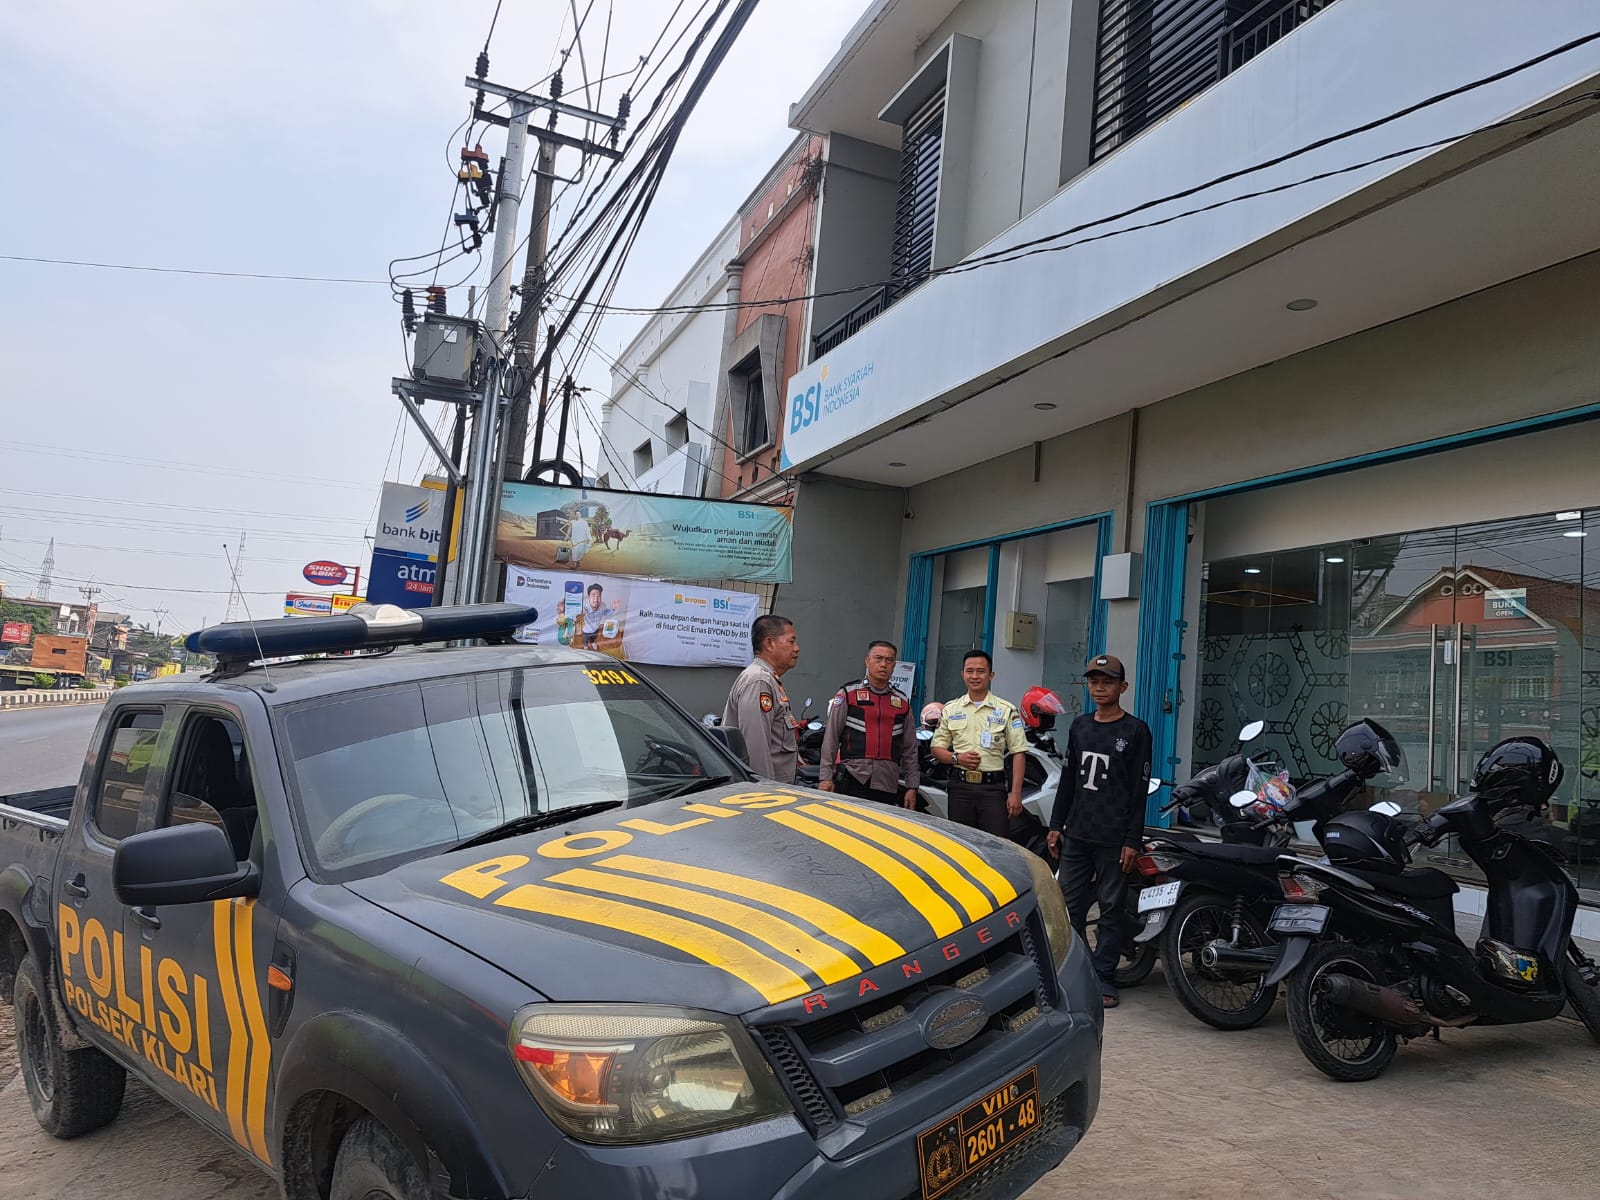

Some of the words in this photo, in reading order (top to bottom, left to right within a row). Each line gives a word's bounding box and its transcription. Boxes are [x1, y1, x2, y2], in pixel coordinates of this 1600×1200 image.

[824, 381, 842, 402] BANK
[844, 362, 874, 389] SYARIAH
[790, 381, 822, 436] BSI
[823, 386, 860, 418] INDONESIA
[738, 510, 755, 520] BSI
[382, 522, 416, 539] bank
[672, 523, 712, 535] Wujudkan
[714, 527, 754, 537] perjalanan
[755, 531, 778, 539] umrah
[716, 536, 737, 544] aman
[738, 537, 753, 545] dan
[754, 539, 777, 547] mudah
[308, 564, 338, 572] SHOP
[397, 563, 436, 583] atm
[408, 582, 417, 591] 24
[418, 583, 434, 593] Jam
[685, 597, 707, 605] BYOND
[713, 598, 729, 610] BSI
[1492, 600, 1517, 609] BUKA
[639, 609, 654, 618] Raih
[654, 612, 670, 620] masa
[670, 612, 690, 622] depan
[690, 615, 712, 625] dengan
[712, 617, 729, 628] harga
[729, 620, 742, 628] saat
[742, 621, 750, 629] ini
[655, 621, 662, 630] di
[662, 622, 677, 631] fitur
[676, 623, 691, 632] Cicil
[691, 625, 707, 634] Emas
[707, 627, 731, 637] BYOND
[731, 629, 739, 638] by
[739, 631, 749, 640] BSI
[1483, 650, 1513, 667] BSI
[582, 669, 625, 685] 3219
[619, 670, 640, 685] A
[891, 676, 909, 684] OTOR
[1080, 750, 1110, 792] T
[439, 787, 830, 900] POLISI
[802, 911, 1019, 1013] RANGER
[58, 902, 213, 1073] POLISI
[63, 978, 140, 1054] POLSEK
[141, 1029, 220, 1113] KLARI
[967, 1117, 1004, 1165] 2601
[1018, 1098, 1036, 1128] 48
